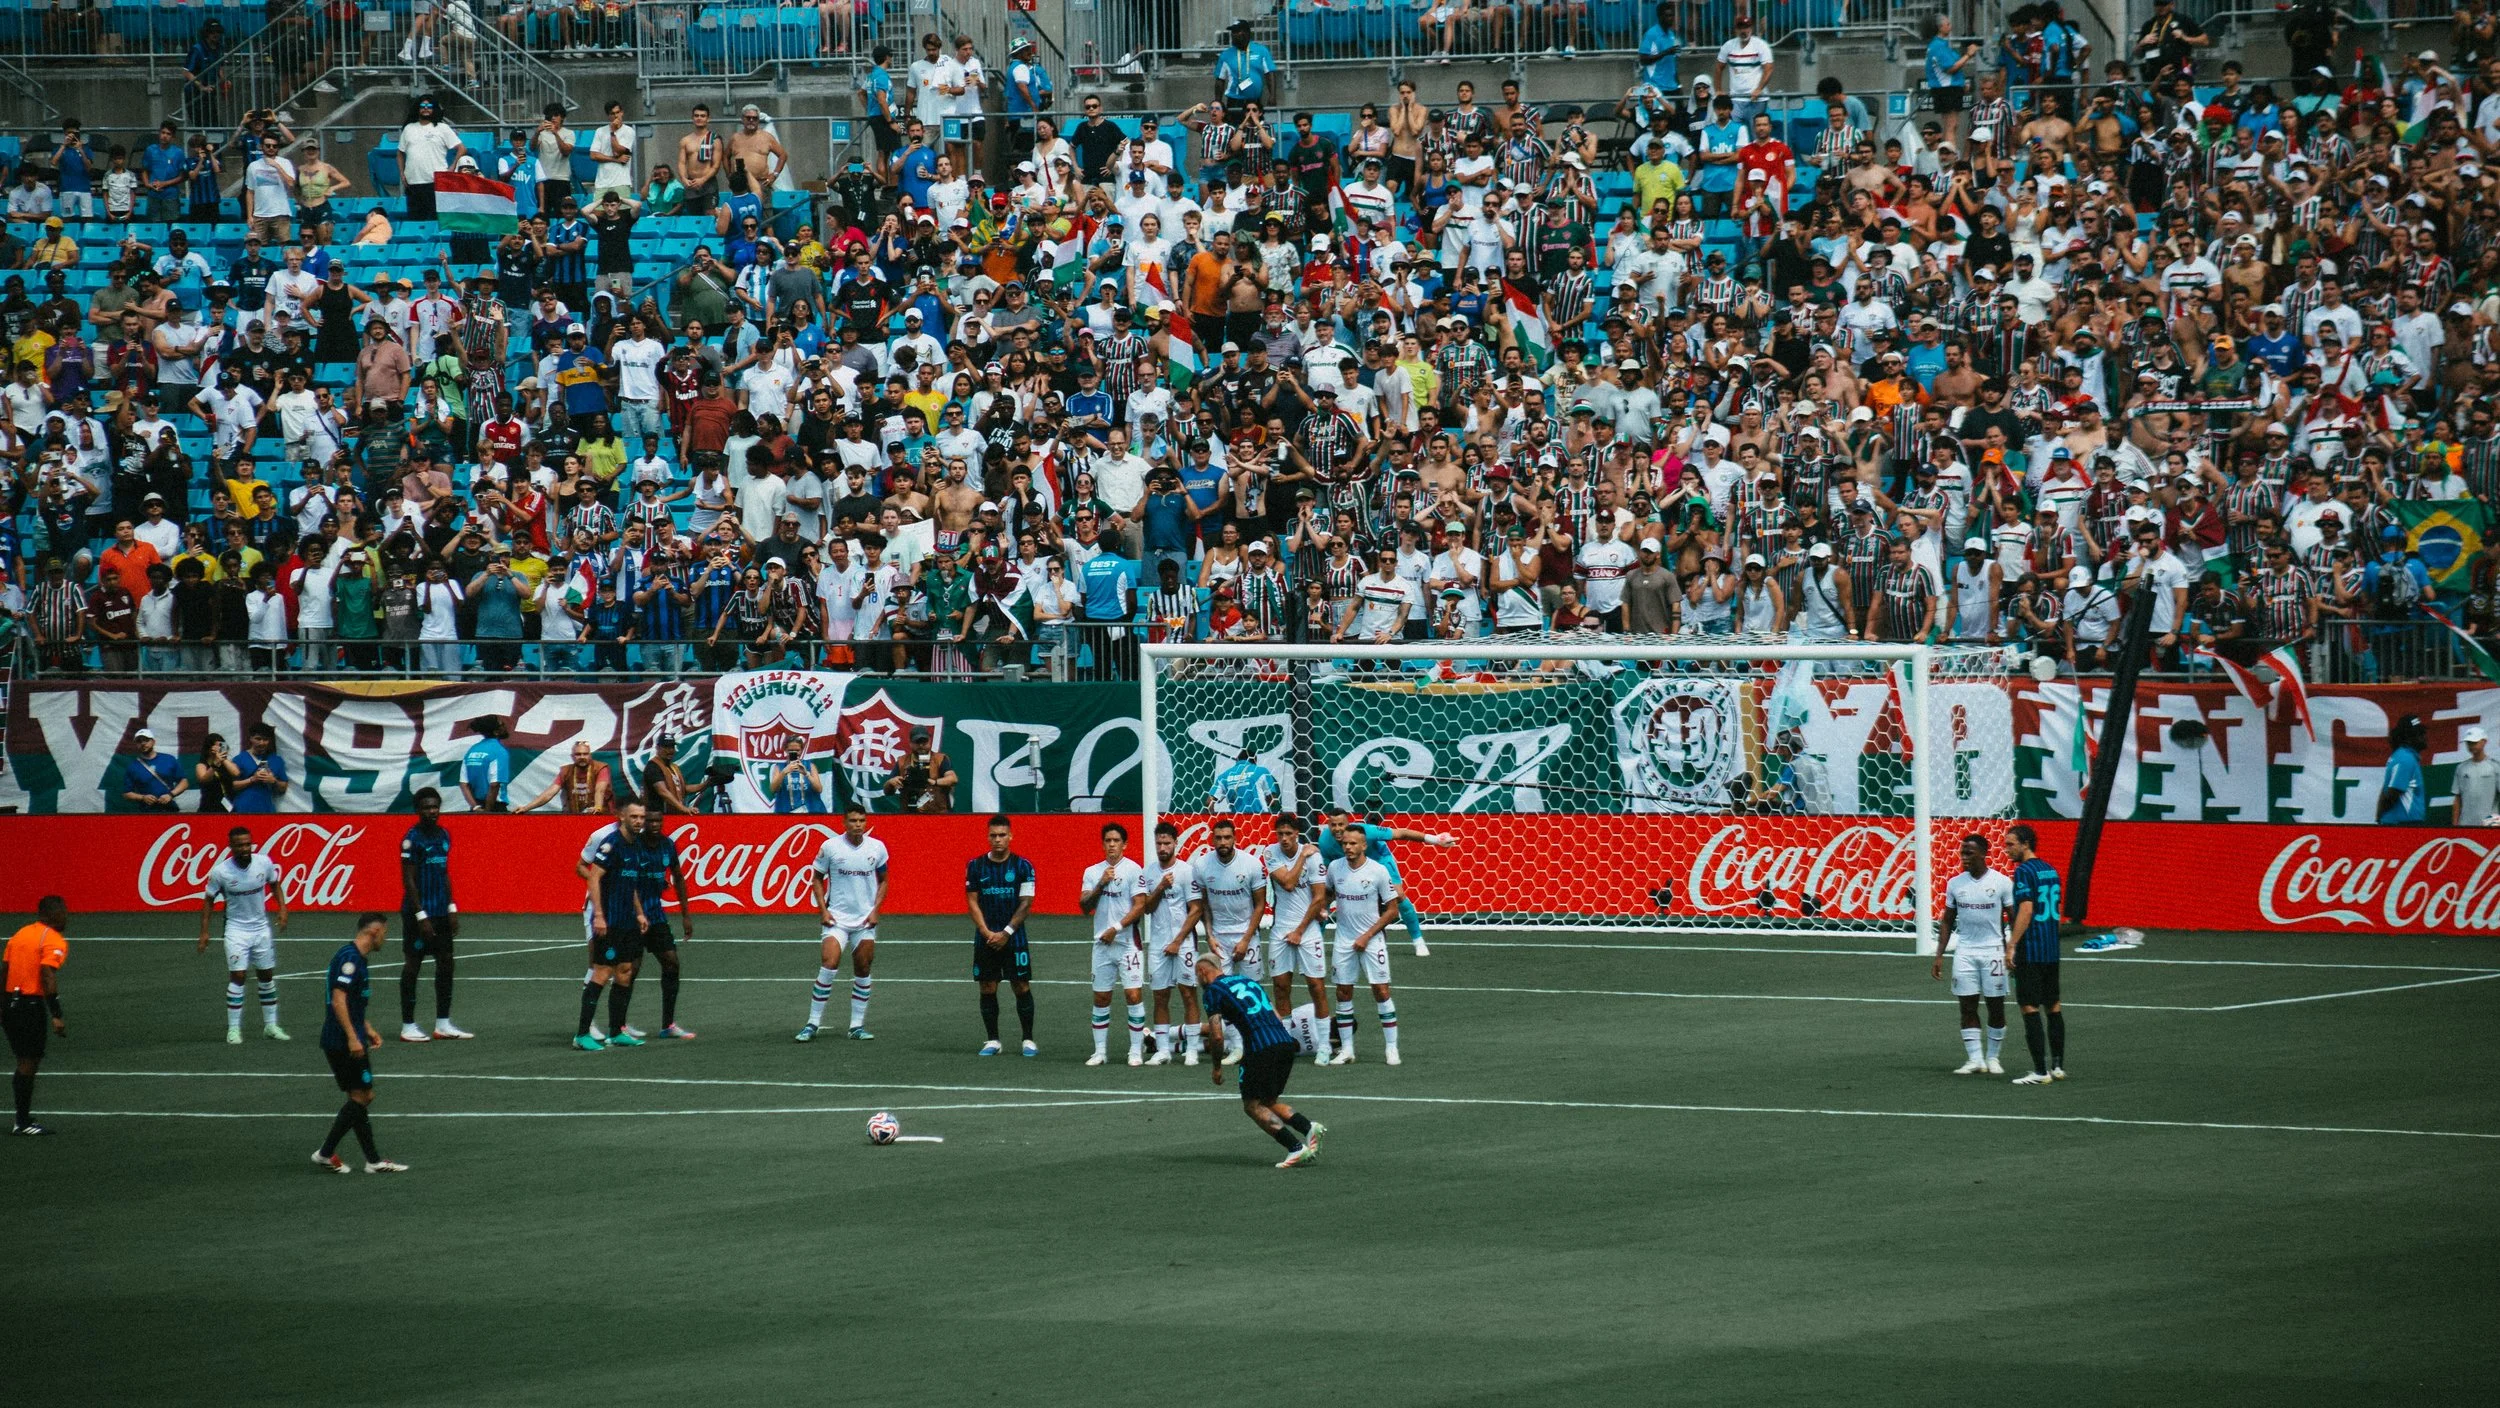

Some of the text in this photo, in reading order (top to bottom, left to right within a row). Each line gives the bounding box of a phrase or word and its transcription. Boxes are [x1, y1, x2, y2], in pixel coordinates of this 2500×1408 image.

[675, 389, 698, 401] bwin
[493, 442, 516, 450] mirates
[1089, 560, 1120, 568] BEST
[838, 868, 872, 877] SUPERBET
[2258, 834, 2500, 930] Coca-Cola
[981, 886, 1015, 895] betsson
[1209, 887, 1245, 896] SUPERBET
[2034, 884, 2061, 922] 36
[1314, 941, 1322, 959] 5
[1377, 949, 1385, 965] 6
[1014, 951, 1028, 967] 10
[1125, 952, 1140, 971] 14
[1184, 951, 1193, 968] 8
[1989, 958, 2004, 977] 21
[1229, 980, 1274, 1015] 32
[1300, 1017, 1314, 1052] NONATO
